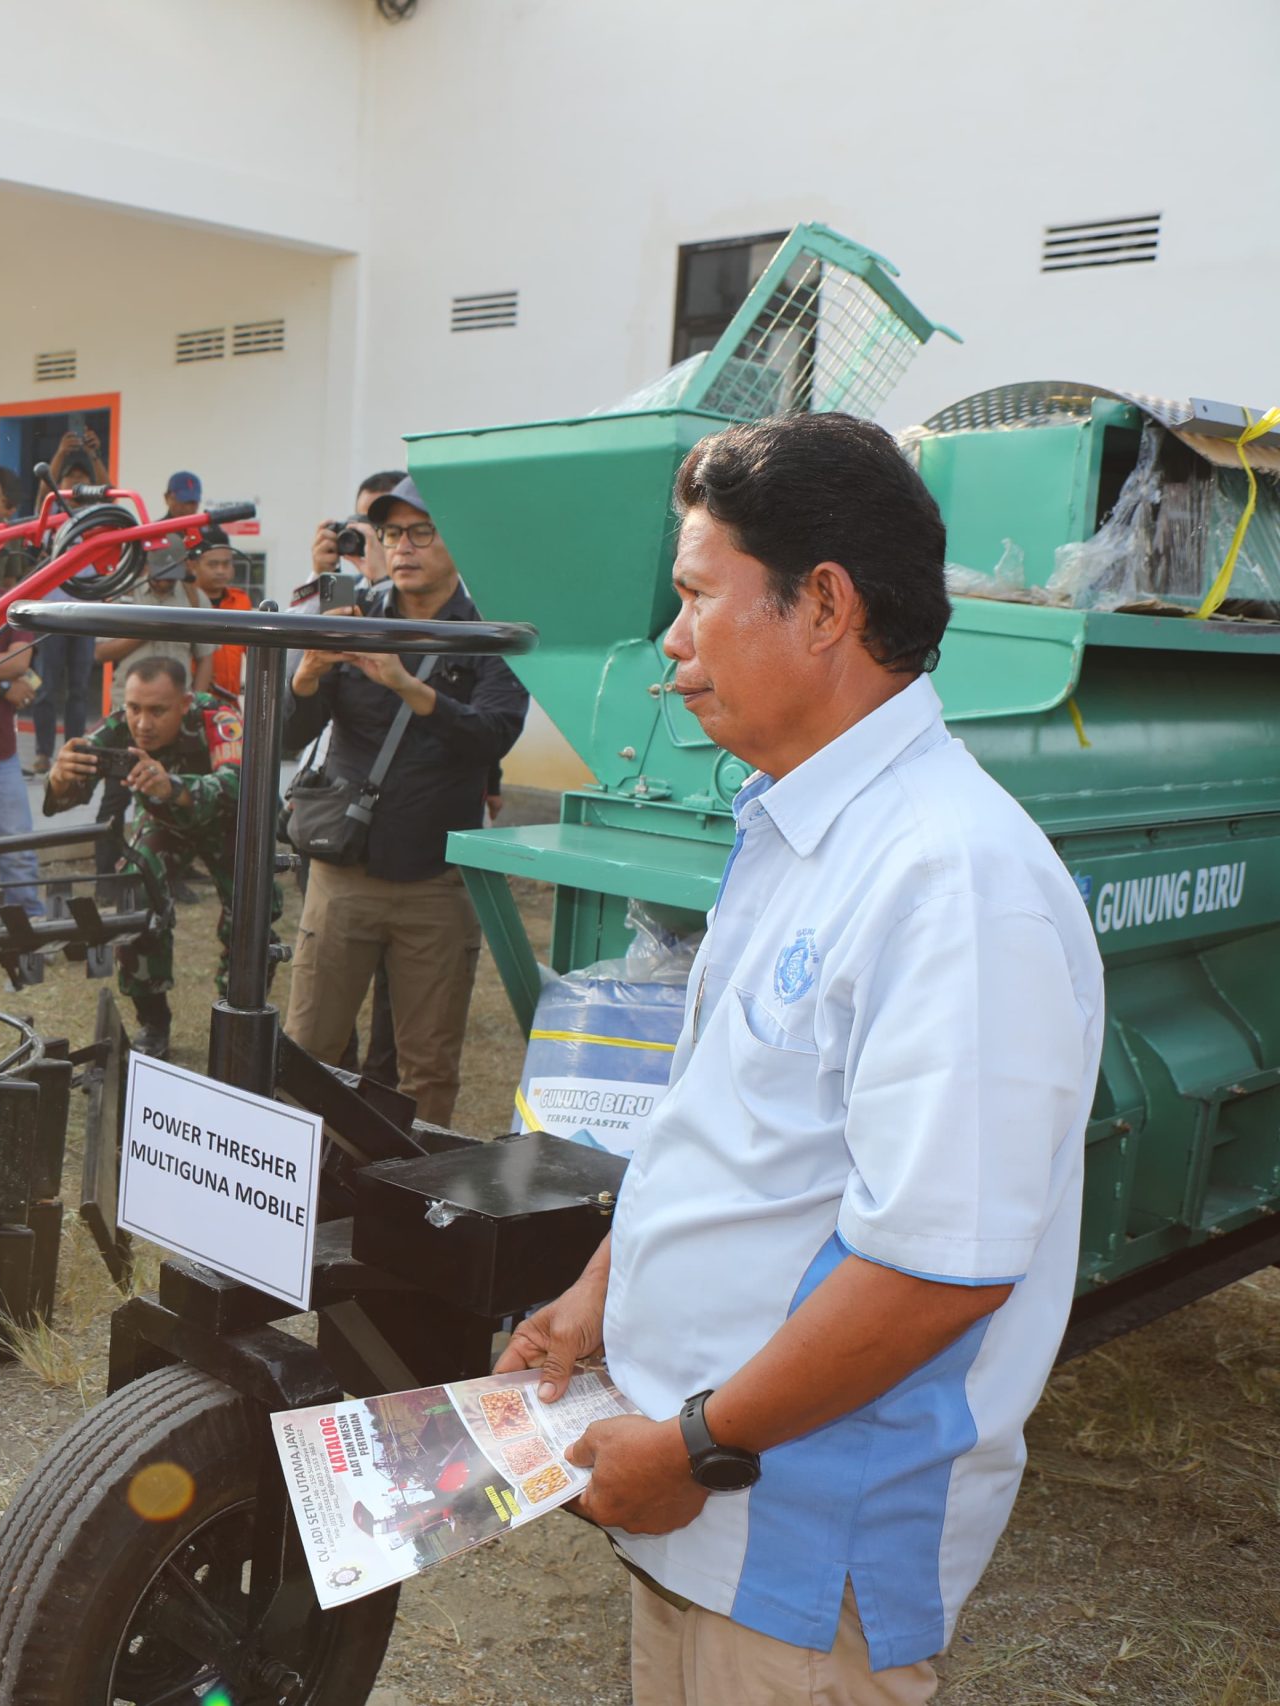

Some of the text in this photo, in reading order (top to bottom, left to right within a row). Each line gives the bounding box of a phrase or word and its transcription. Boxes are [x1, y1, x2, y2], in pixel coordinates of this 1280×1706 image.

[1095, 861, 1246, 934] GUNUNG BIRU
[540, 1088, 653, 1117] GUNUNG BIRU
[546, 1114, 630, 1130] TERPAL PLASTIK
[142, 1107, 297, 1183] POWER THRESHER
[131, 1140, 306, 1228] MULTIGUNA MOBILE
[301, 1447, 314, 1473] Surabaya
[319, 1417, 348, 1473] KATALOG
[337, 1414, 363, 1477] ALAT DAN MESIN
[350, 1413, 369, 1456] PERTANIAN
[282, 1423, 330, 1562] CV. ADI SETIA UTAMA JAYA
